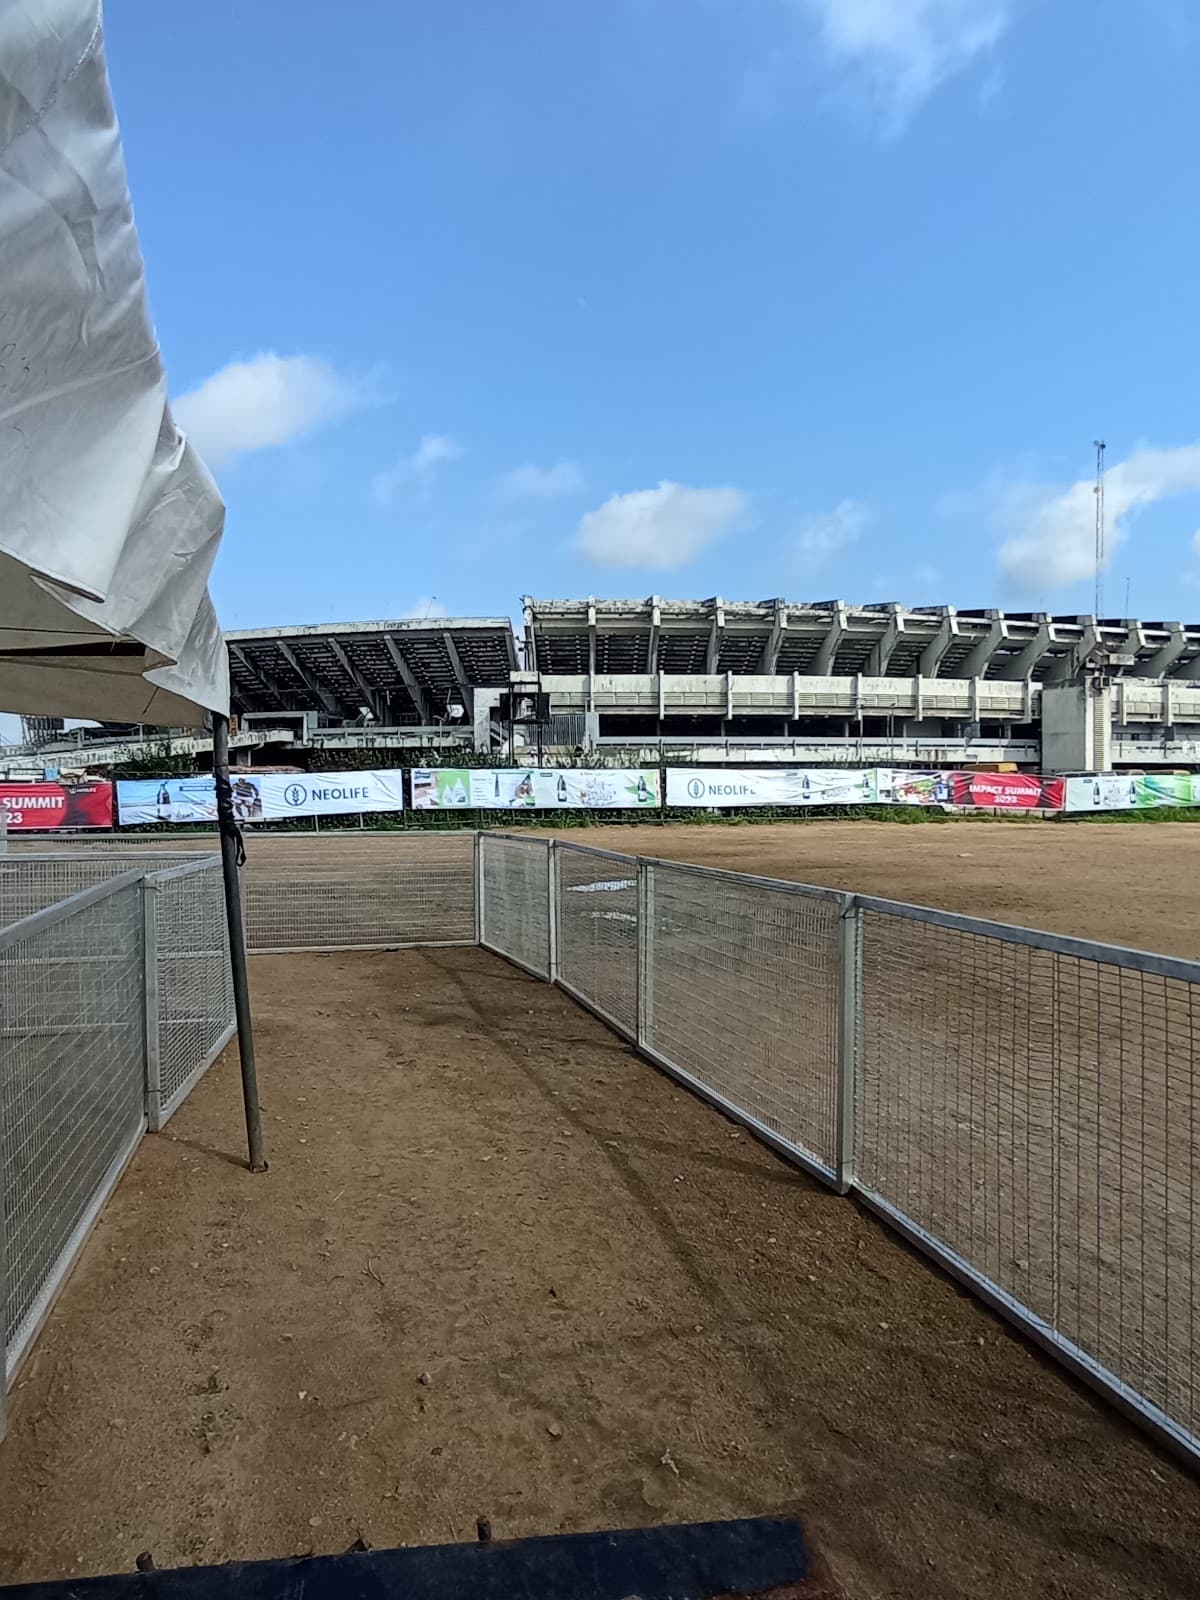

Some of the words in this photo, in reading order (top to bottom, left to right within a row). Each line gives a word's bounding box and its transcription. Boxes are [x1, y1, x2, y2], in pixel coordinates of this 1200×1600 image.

[312, 786, 369, 800] NEOLIFE
[969, 784, 1003, 795] IMPACT
[1004, 786, 1042, 796] SUMMIT
[2, 796, 65, 809] SUMMIT
[6, 812, 23, 823] 23
